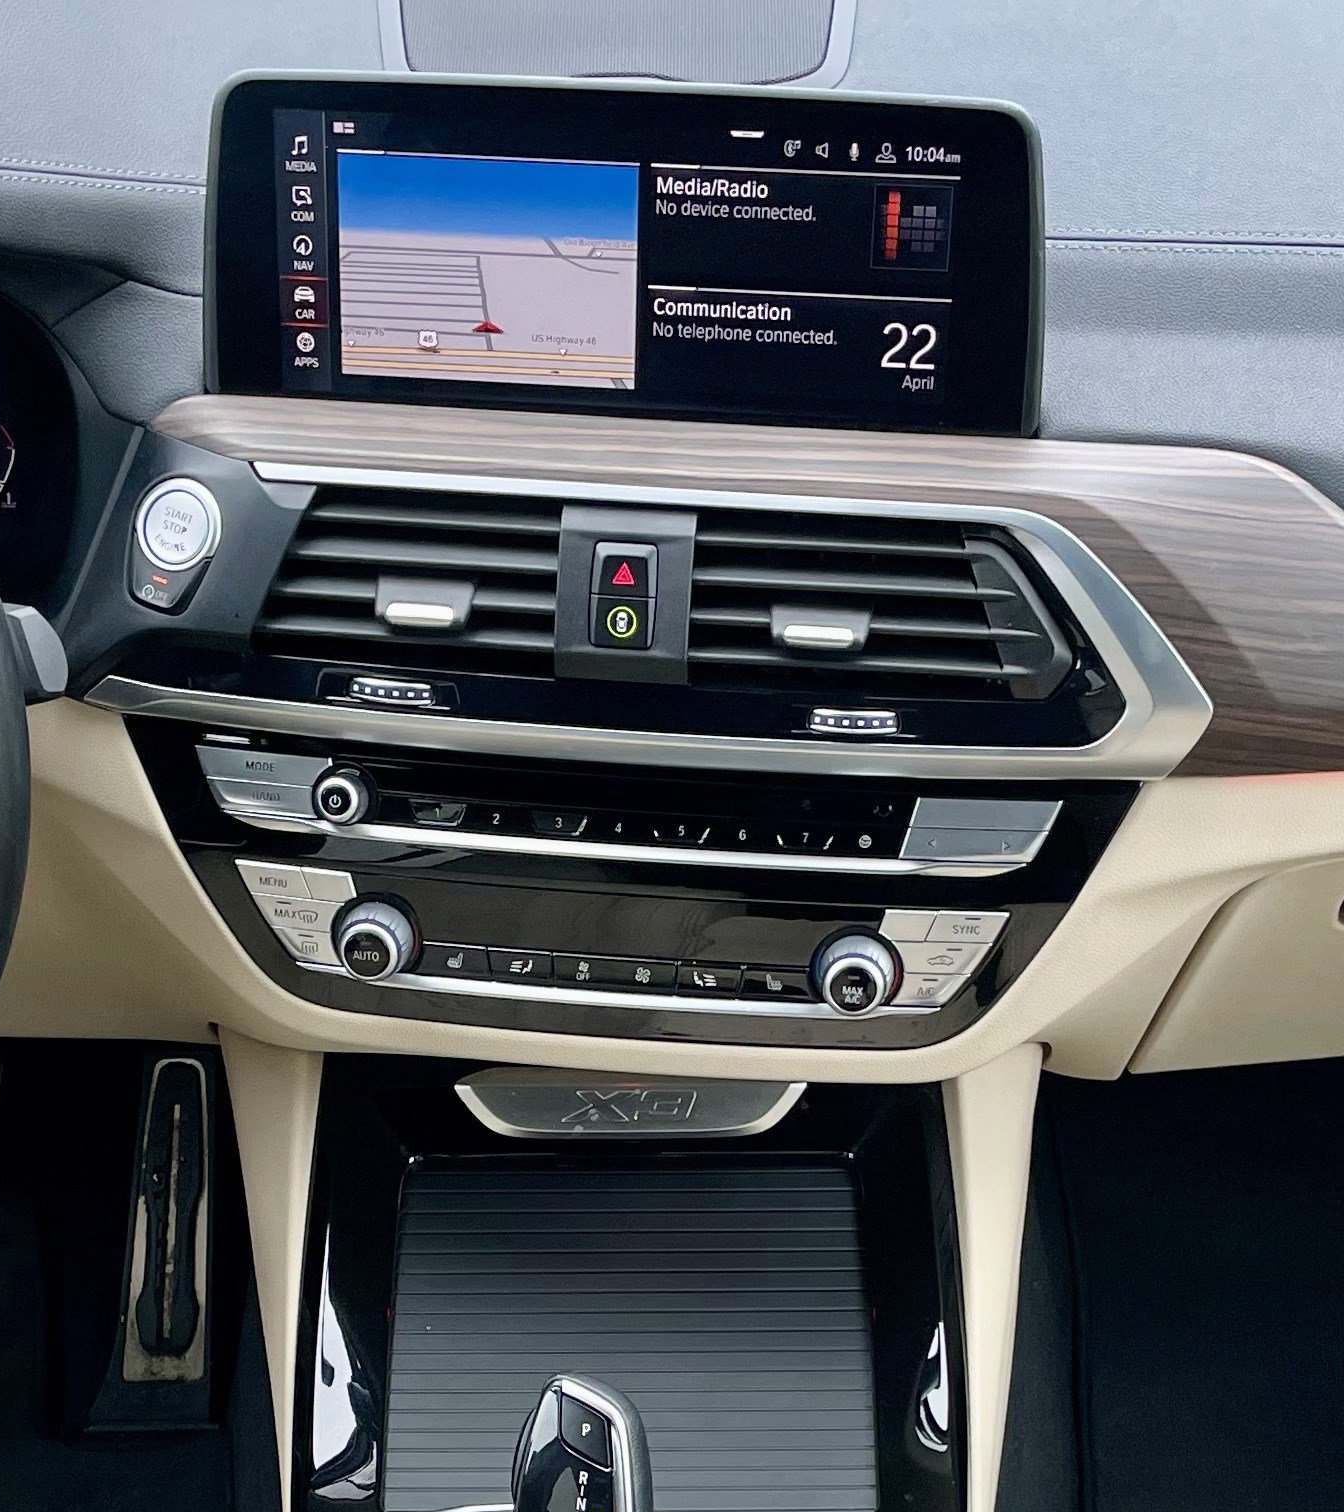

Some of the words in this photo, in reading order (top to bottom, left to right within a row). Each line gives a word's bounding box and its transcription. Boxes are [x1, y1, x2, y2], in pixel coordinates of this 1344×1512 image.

[905, 145, 961, 164] 10:04am
[285, 160, 317, 173] MEDIA
[656, 176, 769, 199] Media/Radio
[290, 210, 314, 223] COM
[655, 199, 677, 215] No
[680, 200, 731, 218] device
[730, 204, 817, 222] connected.
[293, 260, 315, 272] NAV
[295, 308, 316, 320] CAR
[653, 297, 792, 322] Communication
[652, 321, 674, 338] No
[677, 323, 752, 343] telephone
[755, 329, 838, 346] connected.
[531, 334, 544, 343] US
[545, 334, 584, 347] Highway
[879, 321, 938, 370] 22
[294, 356, 320, 369] APPS
[902, 374, 935, 392] April
[164, 506, 194, 524] START
[162, 519, 188, 535] STOP
[245, 760, 276, 773] MODE
[435, 807, 443, 818] 1
[492, 814, 501, 826] 2
[555, 818, 563, 829] 3
[614, 823, 622, 835] 4
[678, 826, 686, 837] 5
[739, 829, 746, 841] 6
[803, 832, 810, 844] 7
[259, 876, 288, 889] MENU
[274, 907, 297, 920] MAX
[952, 924, 982, 936] SYNC
[353, 949, 380, 962] AUTO
[575, 971, 591, 982] OFF
[841, 985, 864, 996] MAX
[581, 1423, 591, 1437] P
[578, 1470, 588, 1486] R
[576, 1497, 587, 1512] N
